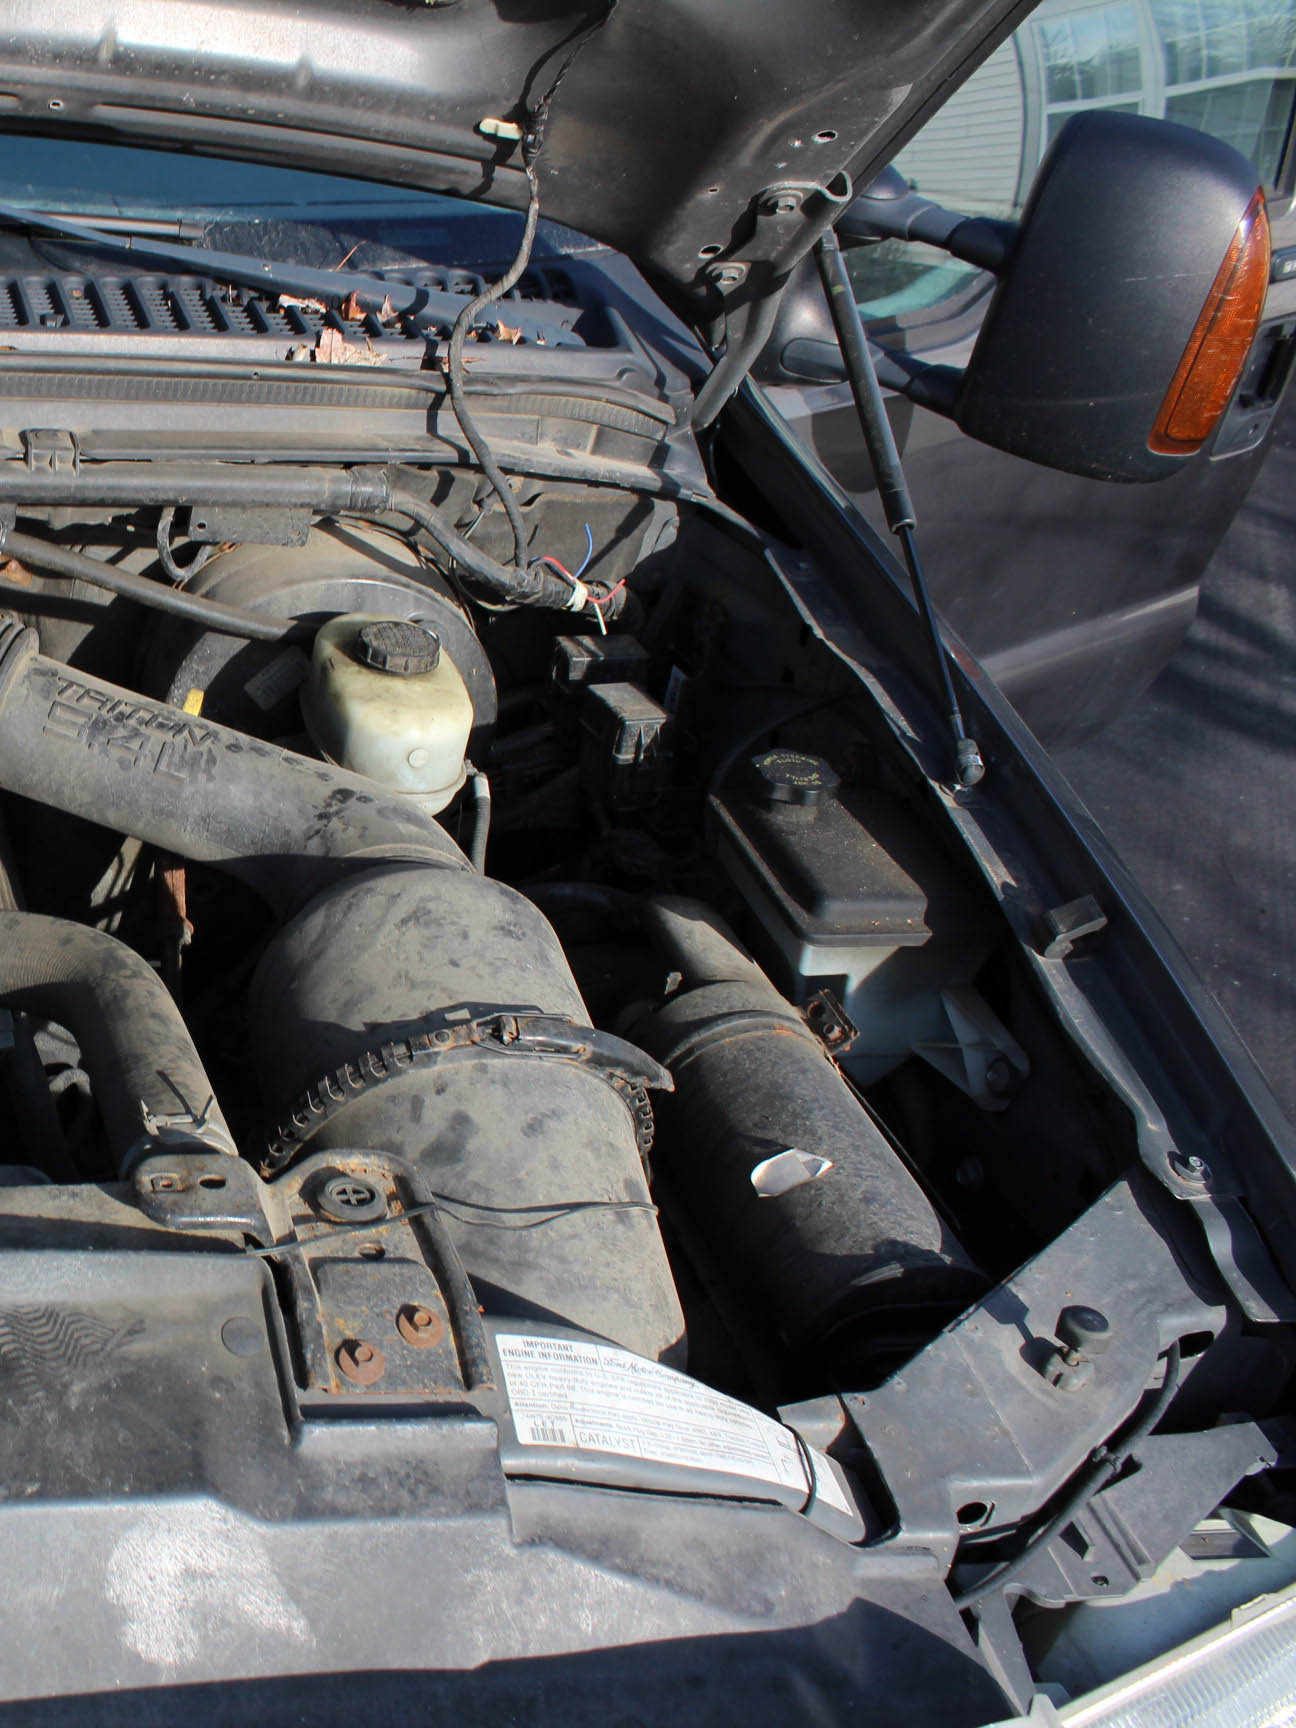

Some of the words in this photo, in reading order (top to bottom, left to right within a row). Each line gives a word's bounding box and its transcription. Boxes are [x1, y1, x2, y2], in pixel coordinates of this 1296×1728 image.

[56, 675, 219, 748] TRITON
[521, 1339, 574, 1353] IMPORTANT
[502, 1347, 537, 1360] ENGINE
[538, 1350, 599, 1366] INFORMATION
[579, 1431, 637, 1453] CATALYST
